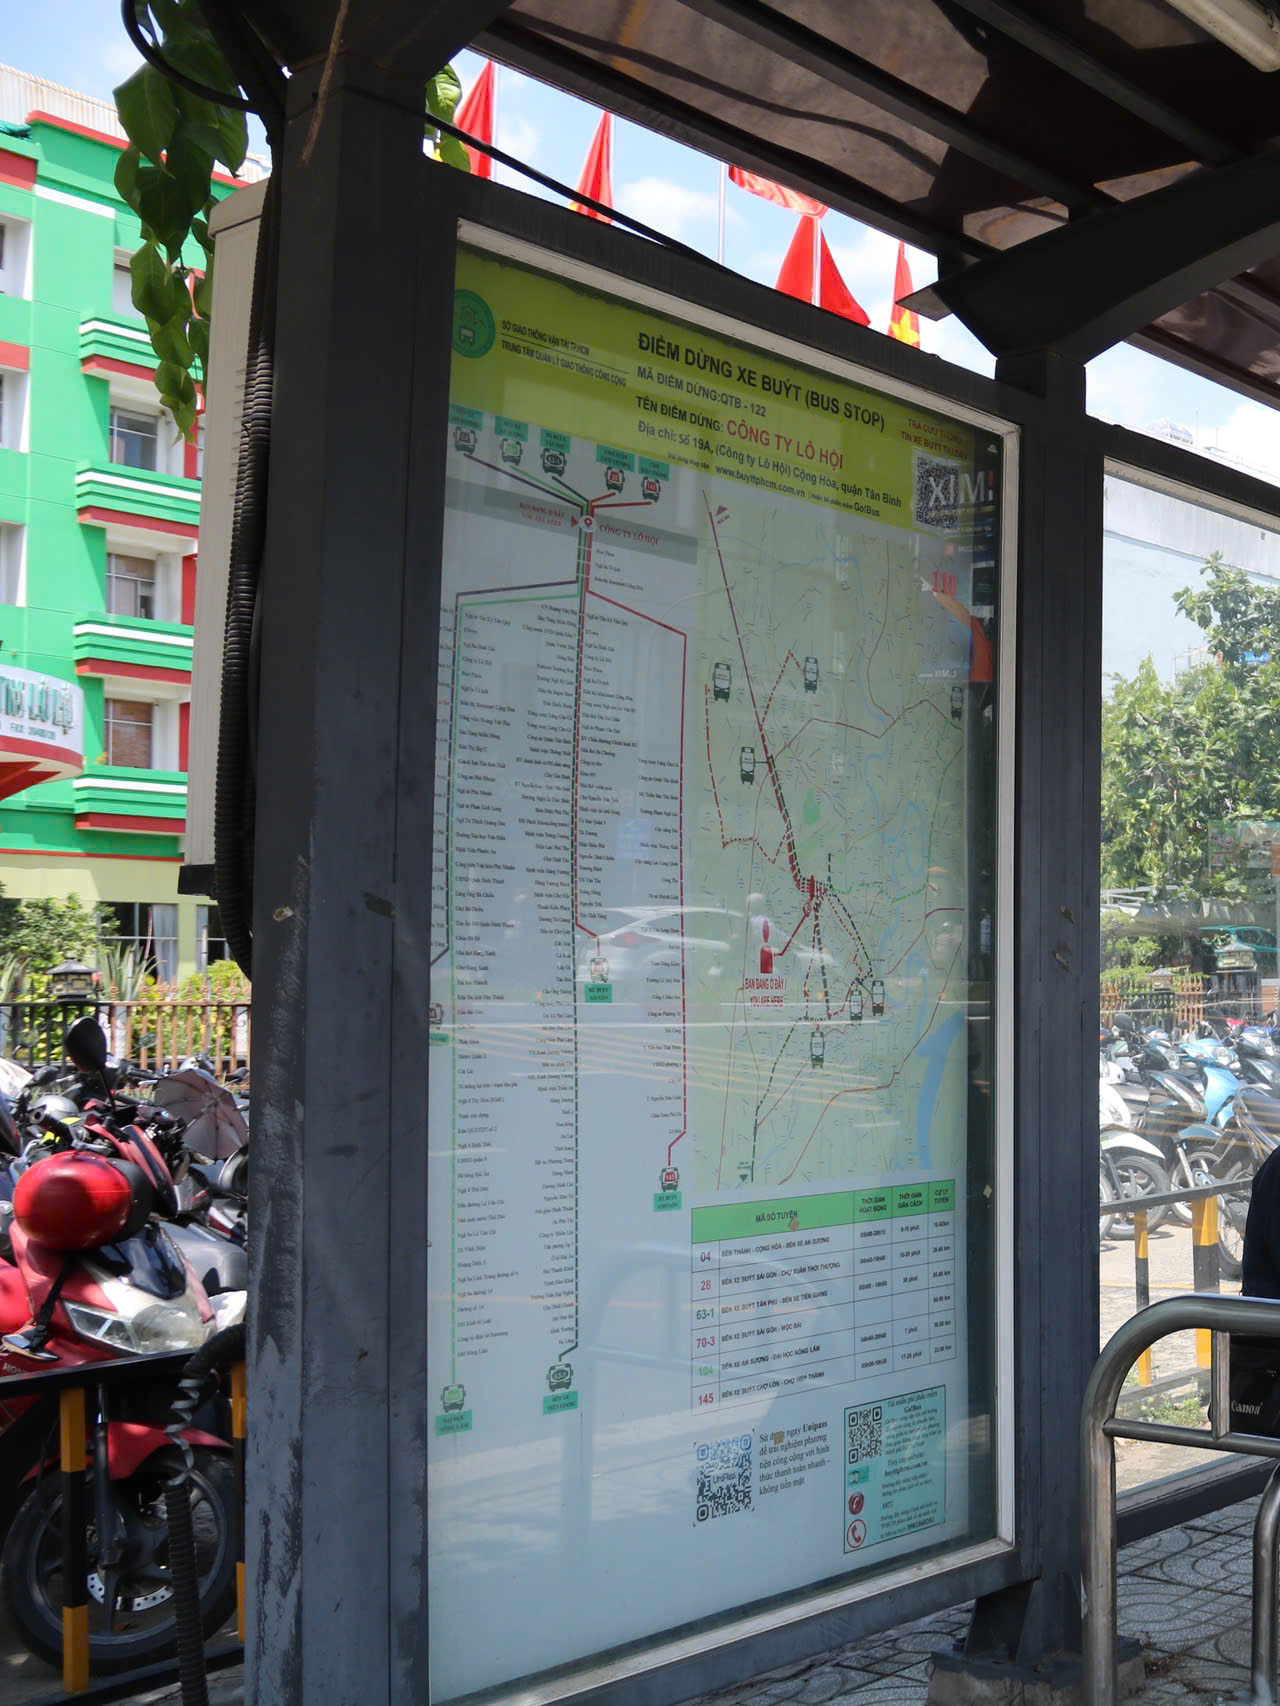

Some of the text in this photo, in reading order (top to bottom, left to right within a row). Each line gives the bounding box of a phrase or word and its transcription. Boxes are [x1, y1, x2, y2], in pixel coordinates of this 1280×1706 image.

[638, 330, 885, 432] ĐIỂM DỪNG XE BUÝT (BUS STOP)
[637, 364, 766, 417] MÃ ĐIỂM DỪNG:QTB 122
[636, 394, 844, 472] TÊN ĐIỂM DỪNG: CÔNG TY LÔ HỘI
[638, 420, 655, 437] Địa
[693, 436, 714, 454] 19A,
[716, 444, 744, 465] (Công
[746, 454, 756, 468] ty
[758, 456, 770, 469] Lô
[772, 460, 790, 478] Hội)
[792, 466, 817, 486] Cộng
[819, 473, 839, 491] Hòa,
[841, 482, 863, 498] quận
[864, 486, 880, 502] Tân
[882, 491, 902, 508] Bình
[716, 465, 880, 518] www.buyttphcm.com.vn Go!Bus
[750, 995, 784, 1008] YOU ARE HERE
[755, 1208, 798, 1224] MÃ SỐ TUYẾN
[700, 1251, 712, 1263] 04
[700, 1279, 712, 1291] 28
[696, 1308, 714, 1320] 63-1
[696, 1336, 716, 1349] 70-3
[698, 1366, 713, 1376] 104
[698, 1392, 714, 1406] 145
[1231, 1400, 1263, 1416] Canon
[760, 1434, 768, 1444] Sử
[786, 1428, 801, 1439] ngay
[803, 1421, 828, 1434] Unipass
[760, 1434, 827, 1456] để trải nghiệm phương
[760, 1444, 830, 1470] tiện công cộng với hình
[712, 1472, 736, 1484] UniPass
[760, 1459, 826, 1482] thức thanh toán nhanh
[760, 1476, 805, 1496] không tiền mặt
